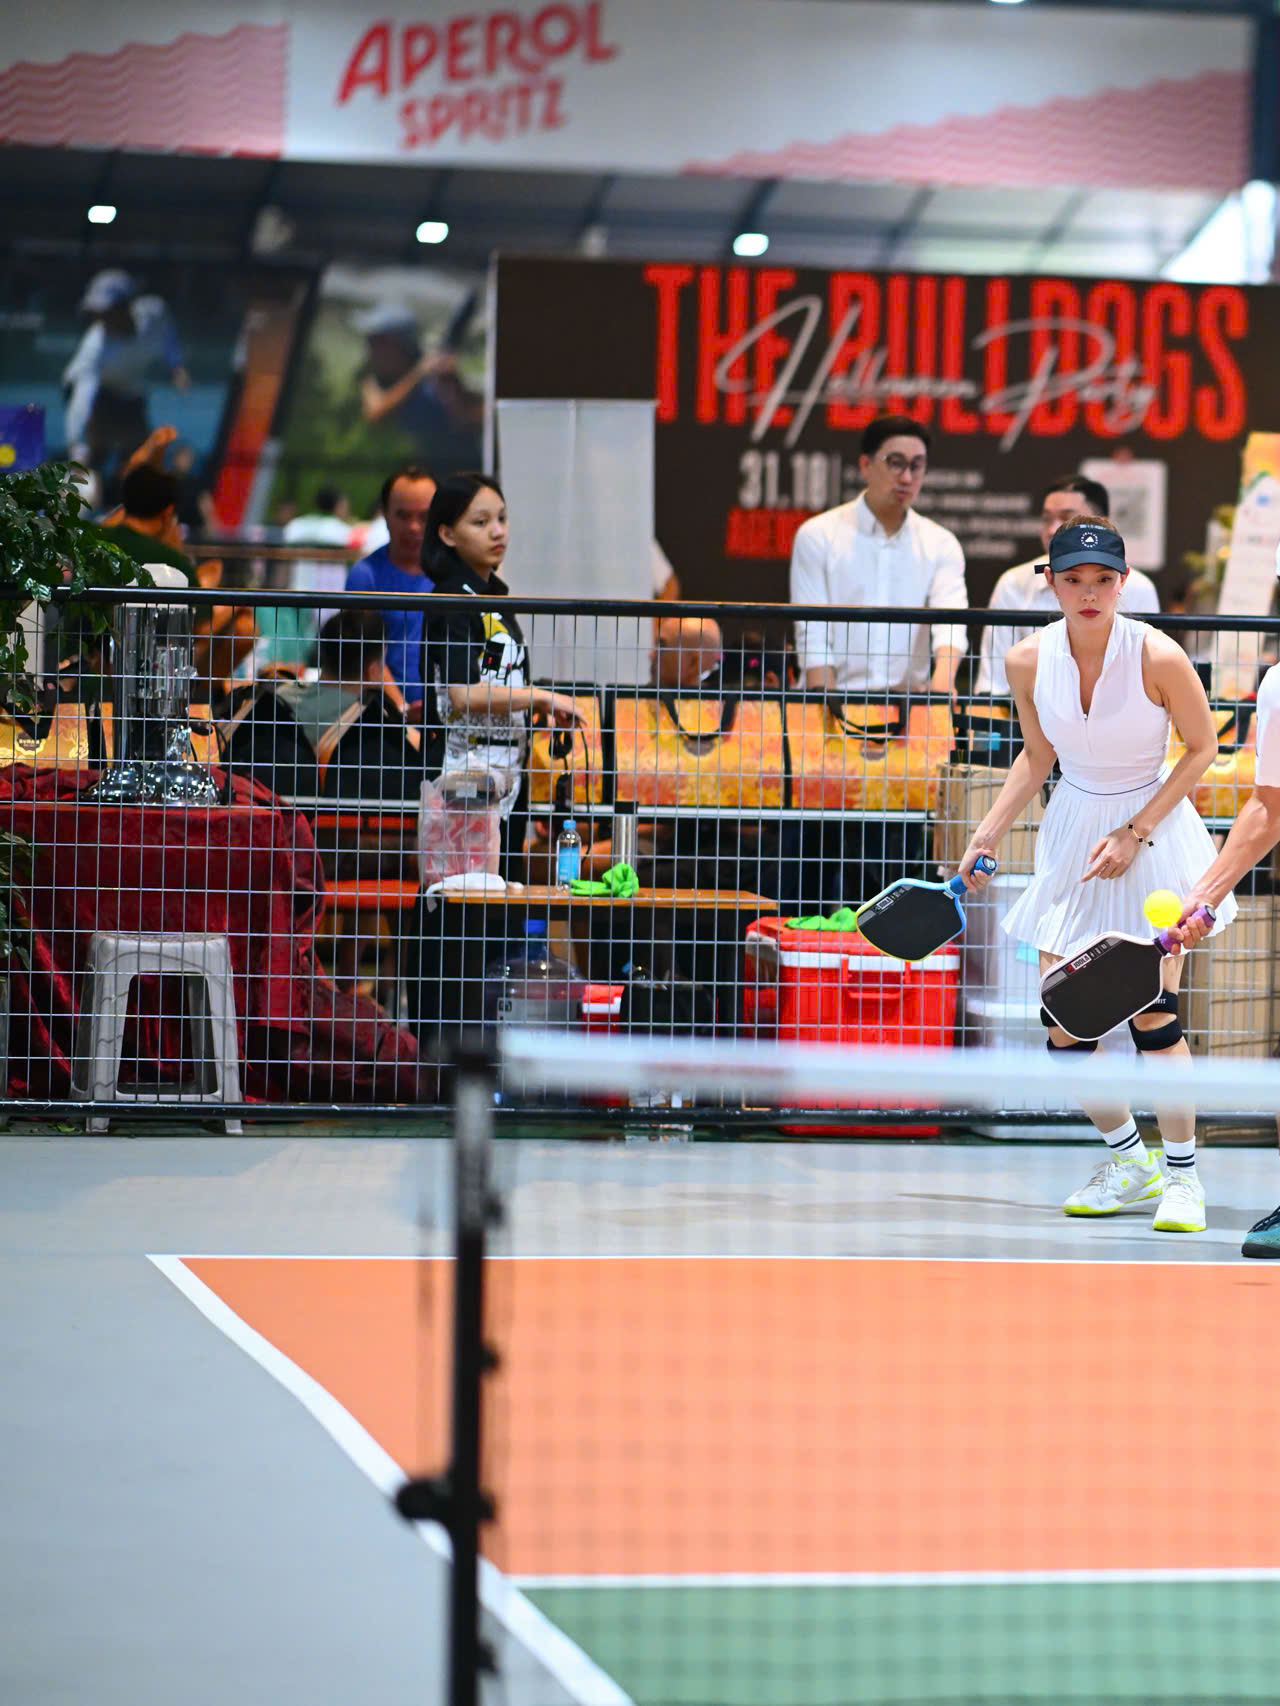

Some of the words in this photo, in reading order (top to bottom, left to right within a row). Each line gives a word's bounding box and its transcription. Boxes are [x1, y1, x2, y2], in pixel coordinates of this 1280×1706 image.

[335, 1, 619, 108] APEROL
[396, 78, 566, 150] SPRITZ
[643, 263, 797, 425] THE
[825, 270, 1250, 442] BULLDOGS
[738, 450, 829, 512] 31.10
[1072, 954, 1090, 969] JOOLA
